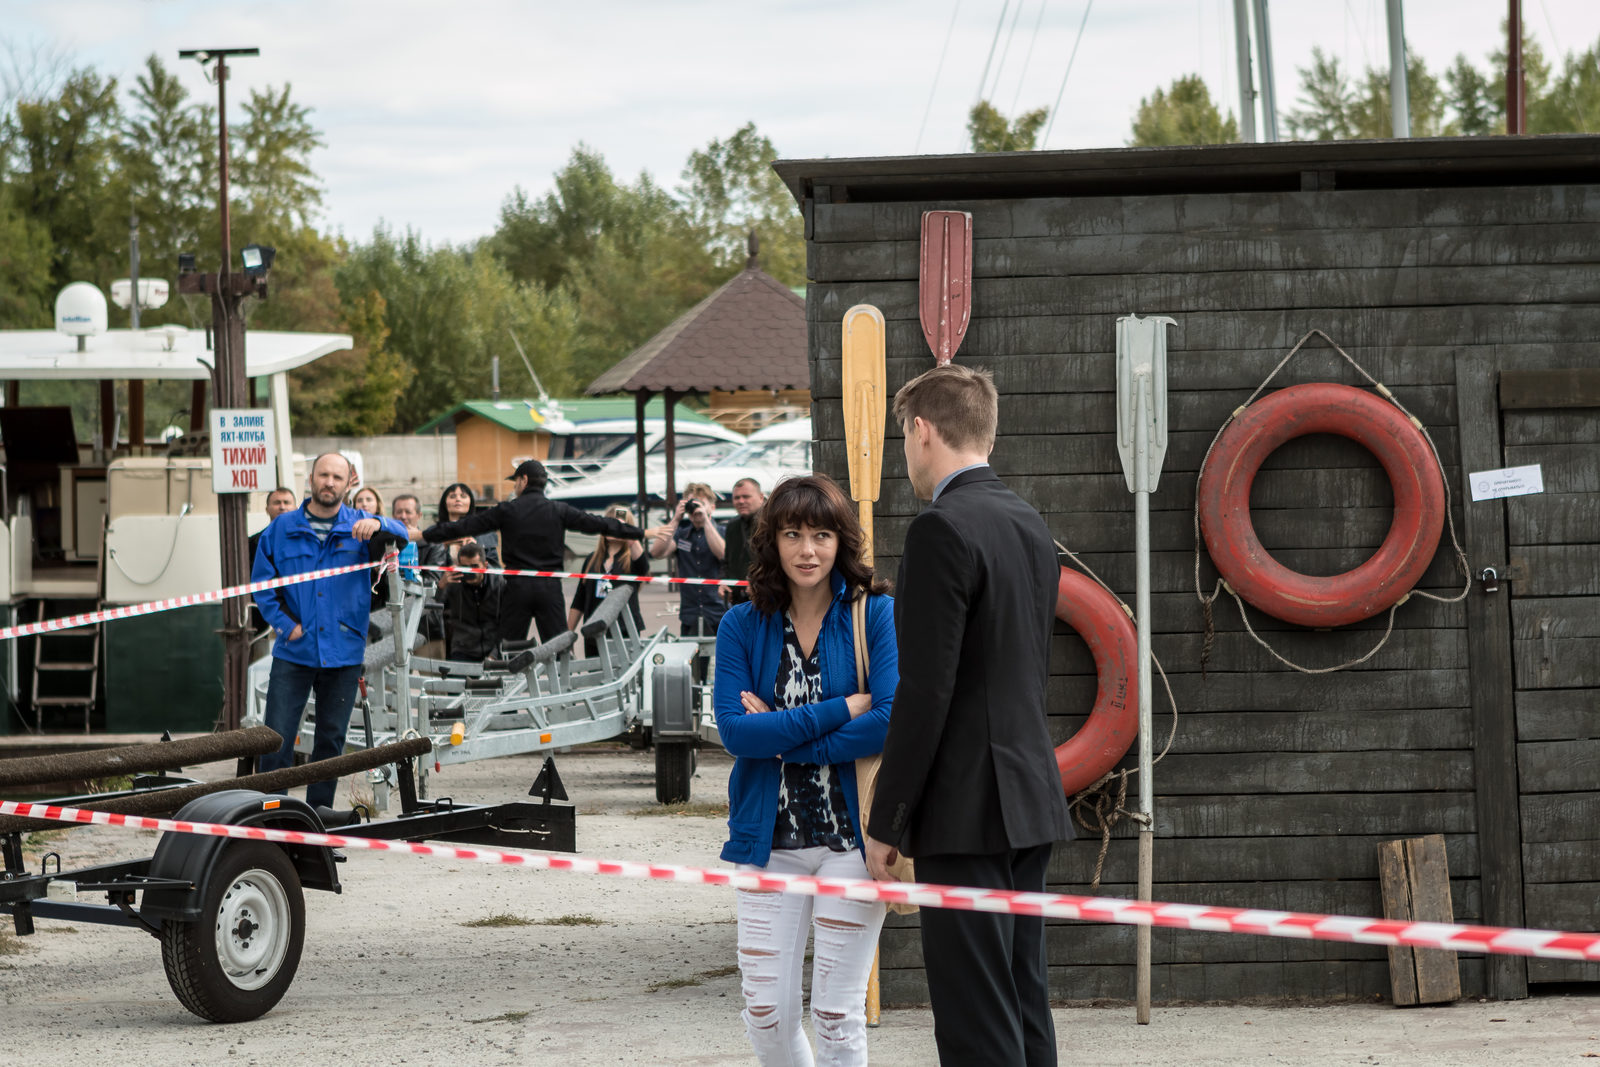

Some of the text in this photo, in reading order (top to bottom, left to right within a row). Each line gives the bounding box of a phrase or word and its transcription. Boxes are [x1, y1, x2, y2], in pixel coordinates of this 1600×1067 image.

[220, 416, 265, 427] В ЗАЛИВЕ
[220, 431, 266, 442] ЯХТ-КЛУБА
[222, 444, 267, 466] ТИХИЙ
[231, 469, 259, 489] ХОД
